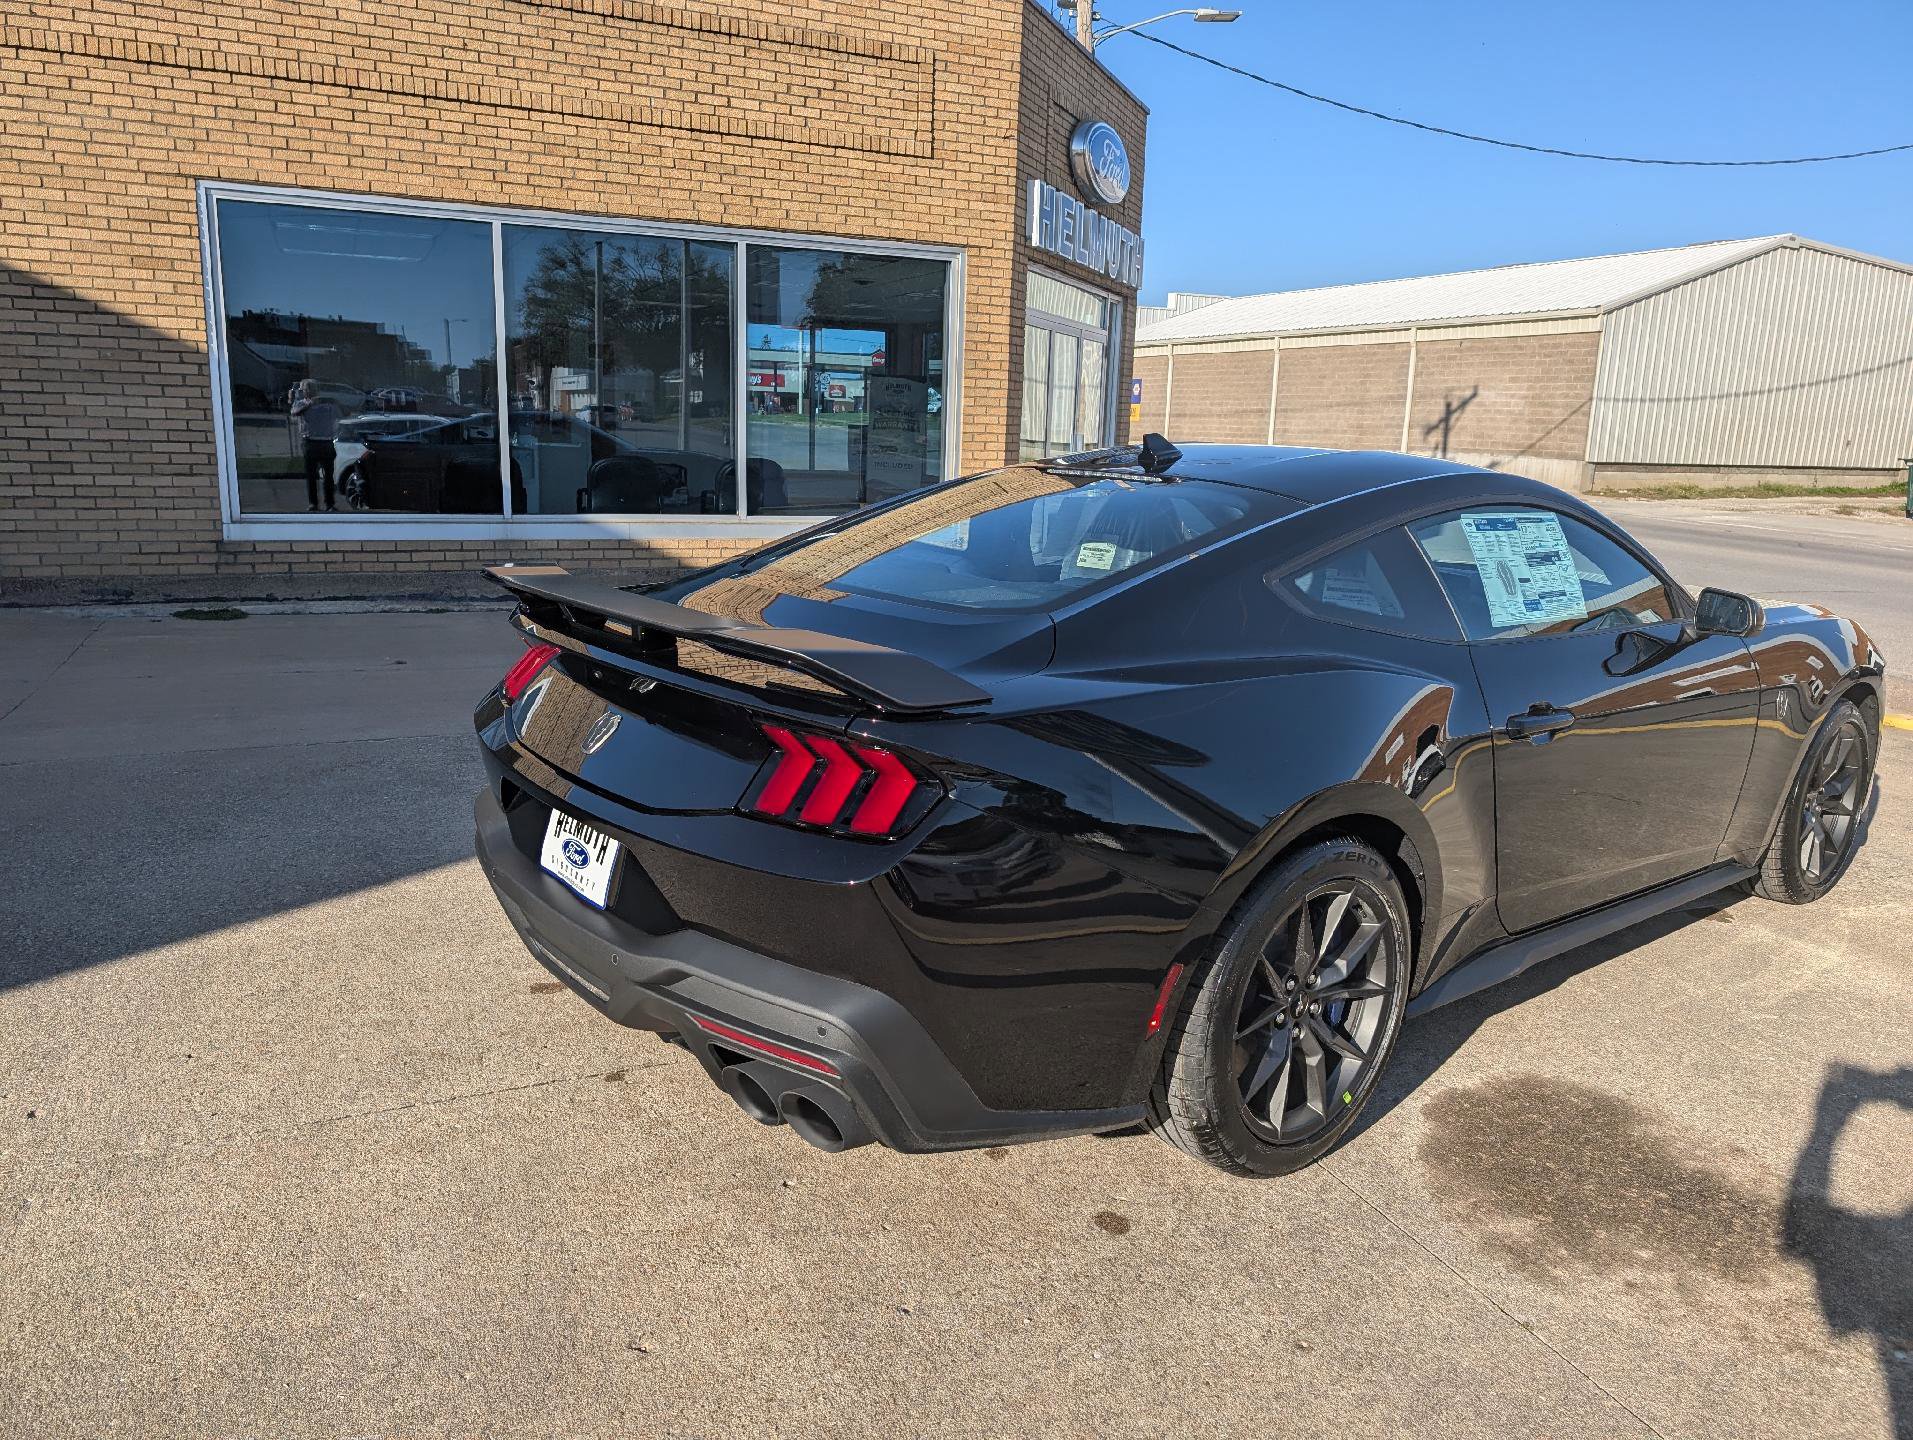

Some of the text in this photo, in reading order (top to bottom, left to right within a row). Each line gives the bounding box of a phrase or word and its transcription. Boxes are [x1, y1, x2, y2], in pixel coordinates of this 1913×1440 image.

[1100, 139, 1126, 187] Ford
[1033, 180, 1143, 289] HELMUTH
[554, 811, 609, 866] HELMUTH
[565, 842, 586, 866] Ford
[1332, 850, 1379, 866] ZERO
